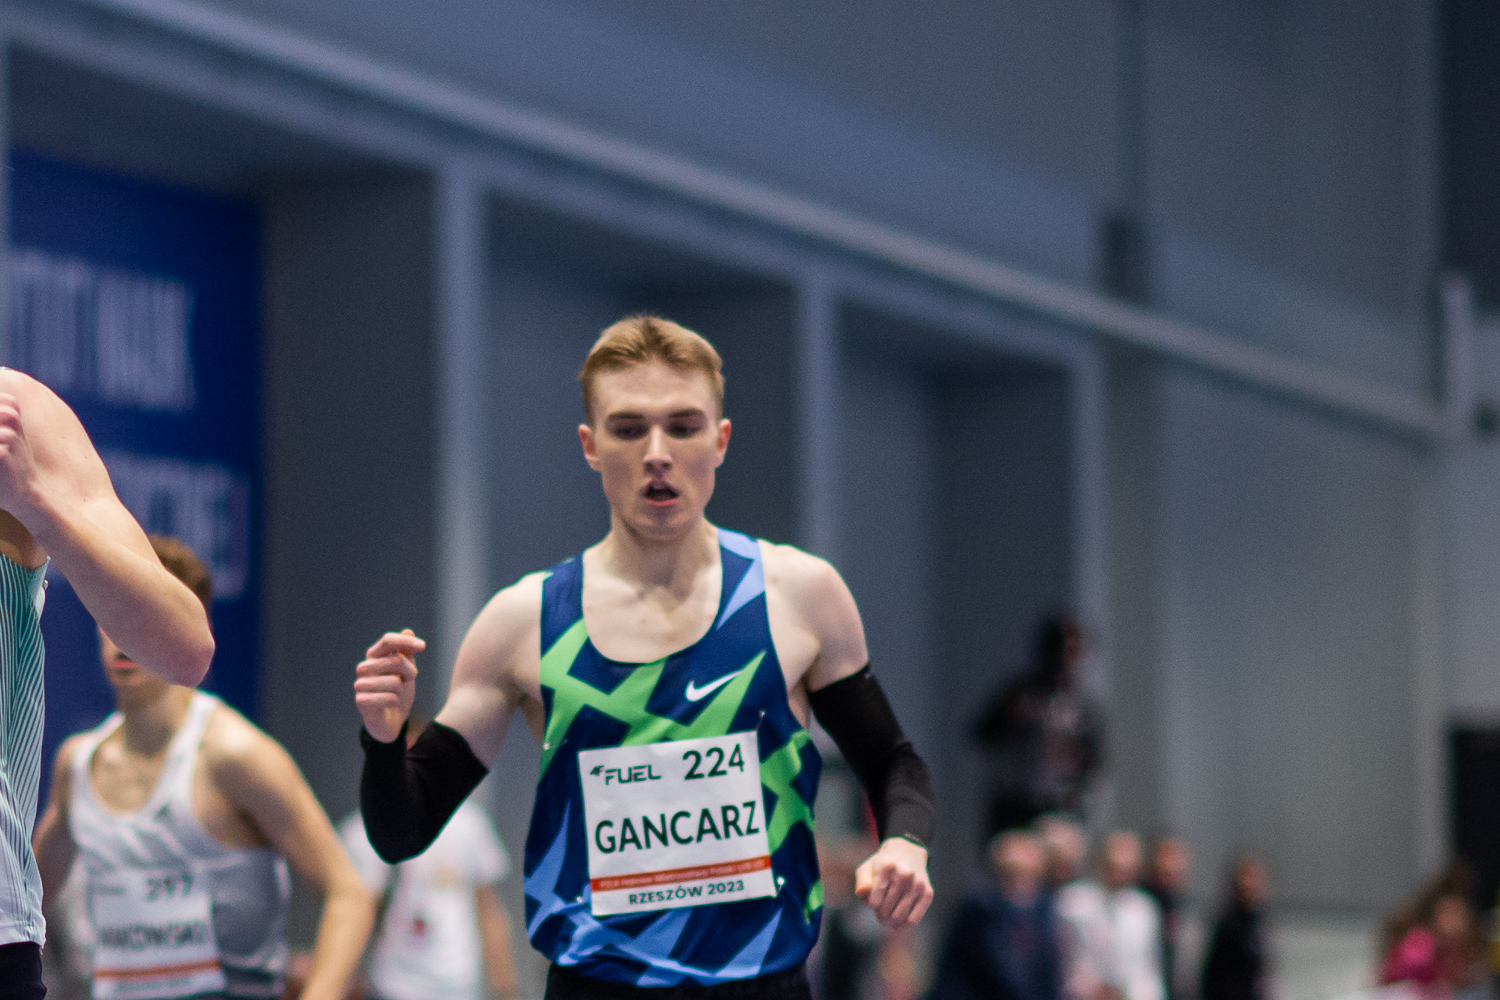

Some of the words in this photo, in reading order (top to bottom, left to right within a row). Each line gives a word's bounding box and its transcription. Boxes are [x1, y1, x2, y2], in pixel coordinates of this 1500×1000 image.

[605, 764, 662, 786] FUEL
[682, 743, 745, 780] 224
[594, 800, 760, 854] GANCARZ
[628, 884, 703, 905] RZESZÓW
[707, 879, 744, 895] 2023
